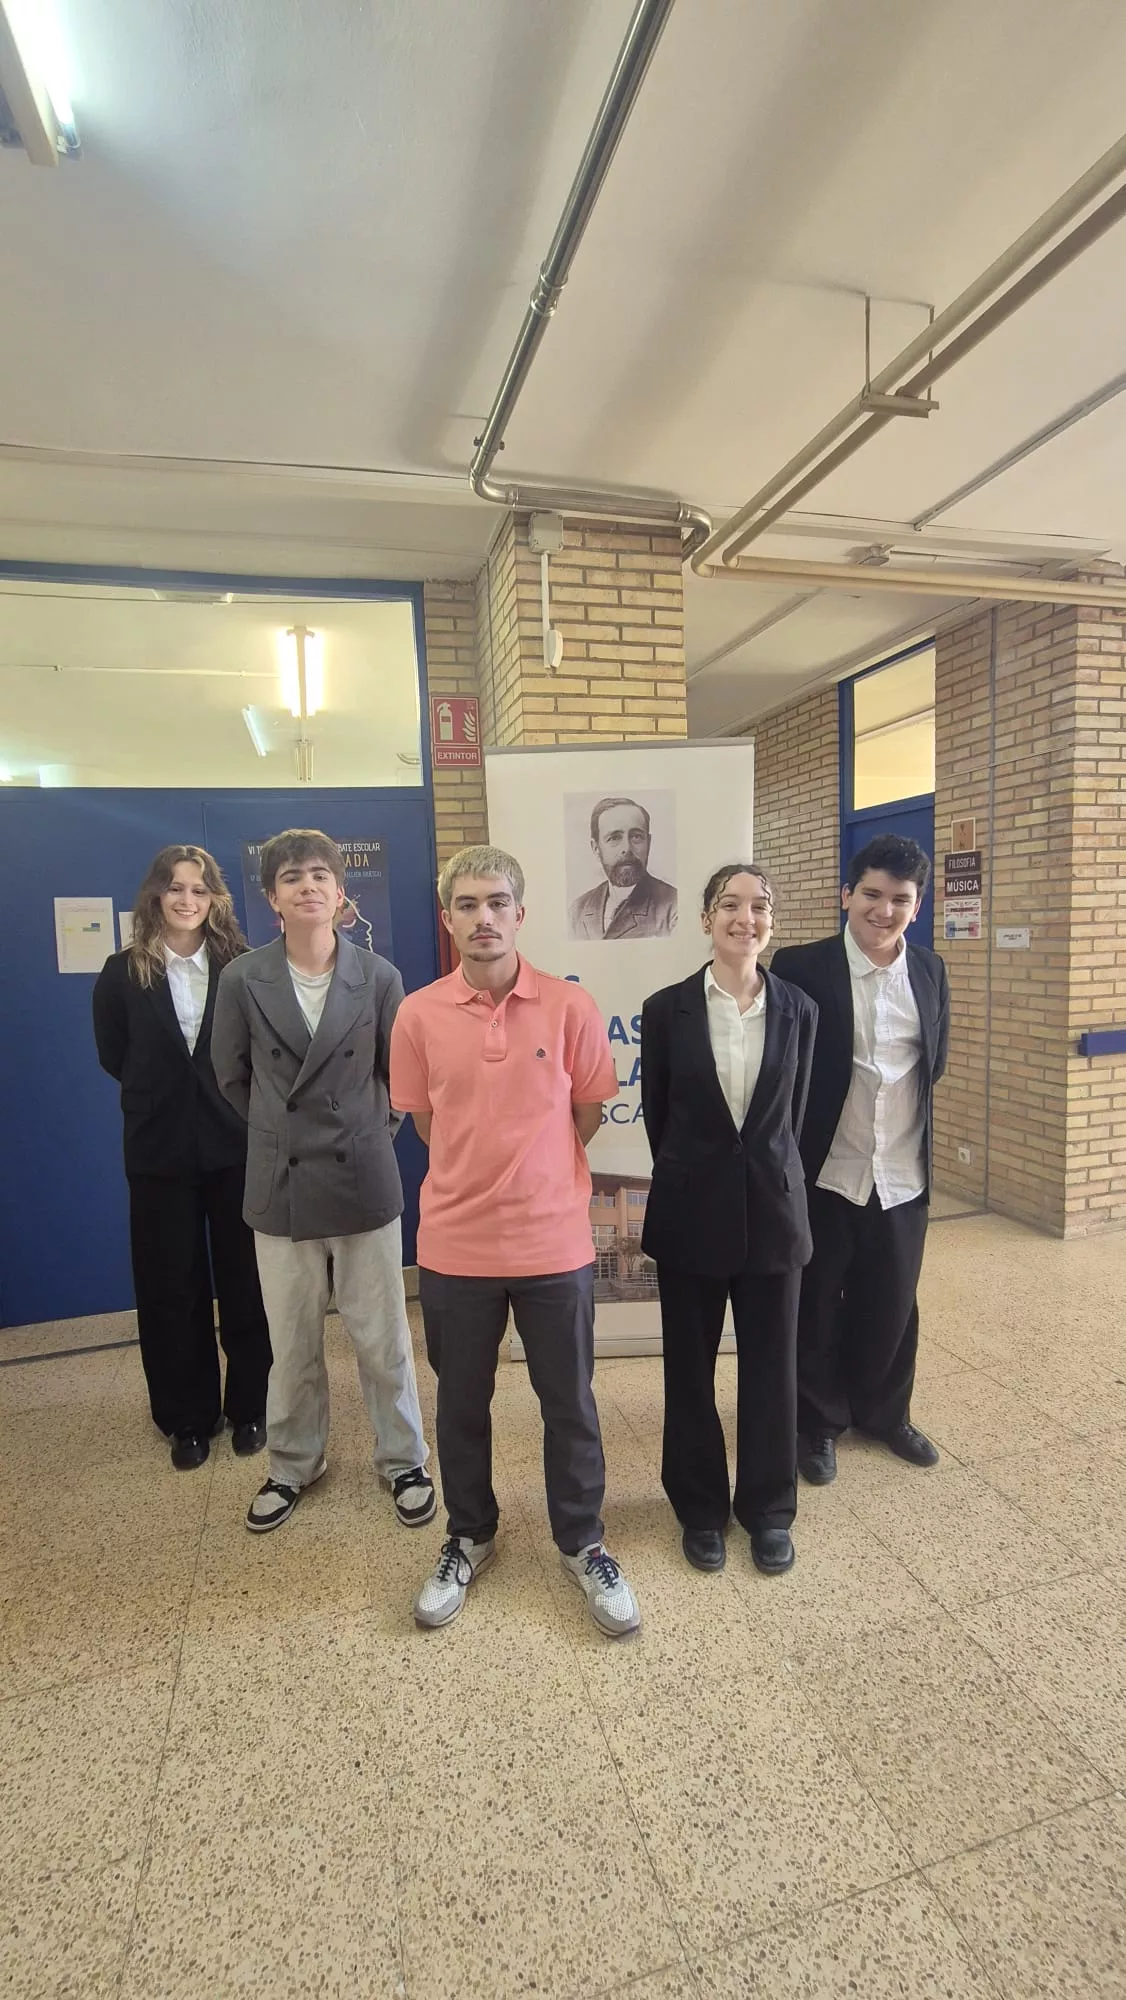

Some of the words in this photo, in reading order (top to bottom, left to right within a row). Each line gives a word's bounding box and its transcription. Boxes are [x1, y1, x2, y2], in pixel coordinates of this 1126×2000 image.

[437, 752, 478, 760] EXTINTOR
[353, 842, 381, 852] ESCOLAR
[946, 879, 979, 893] MÚSICA
